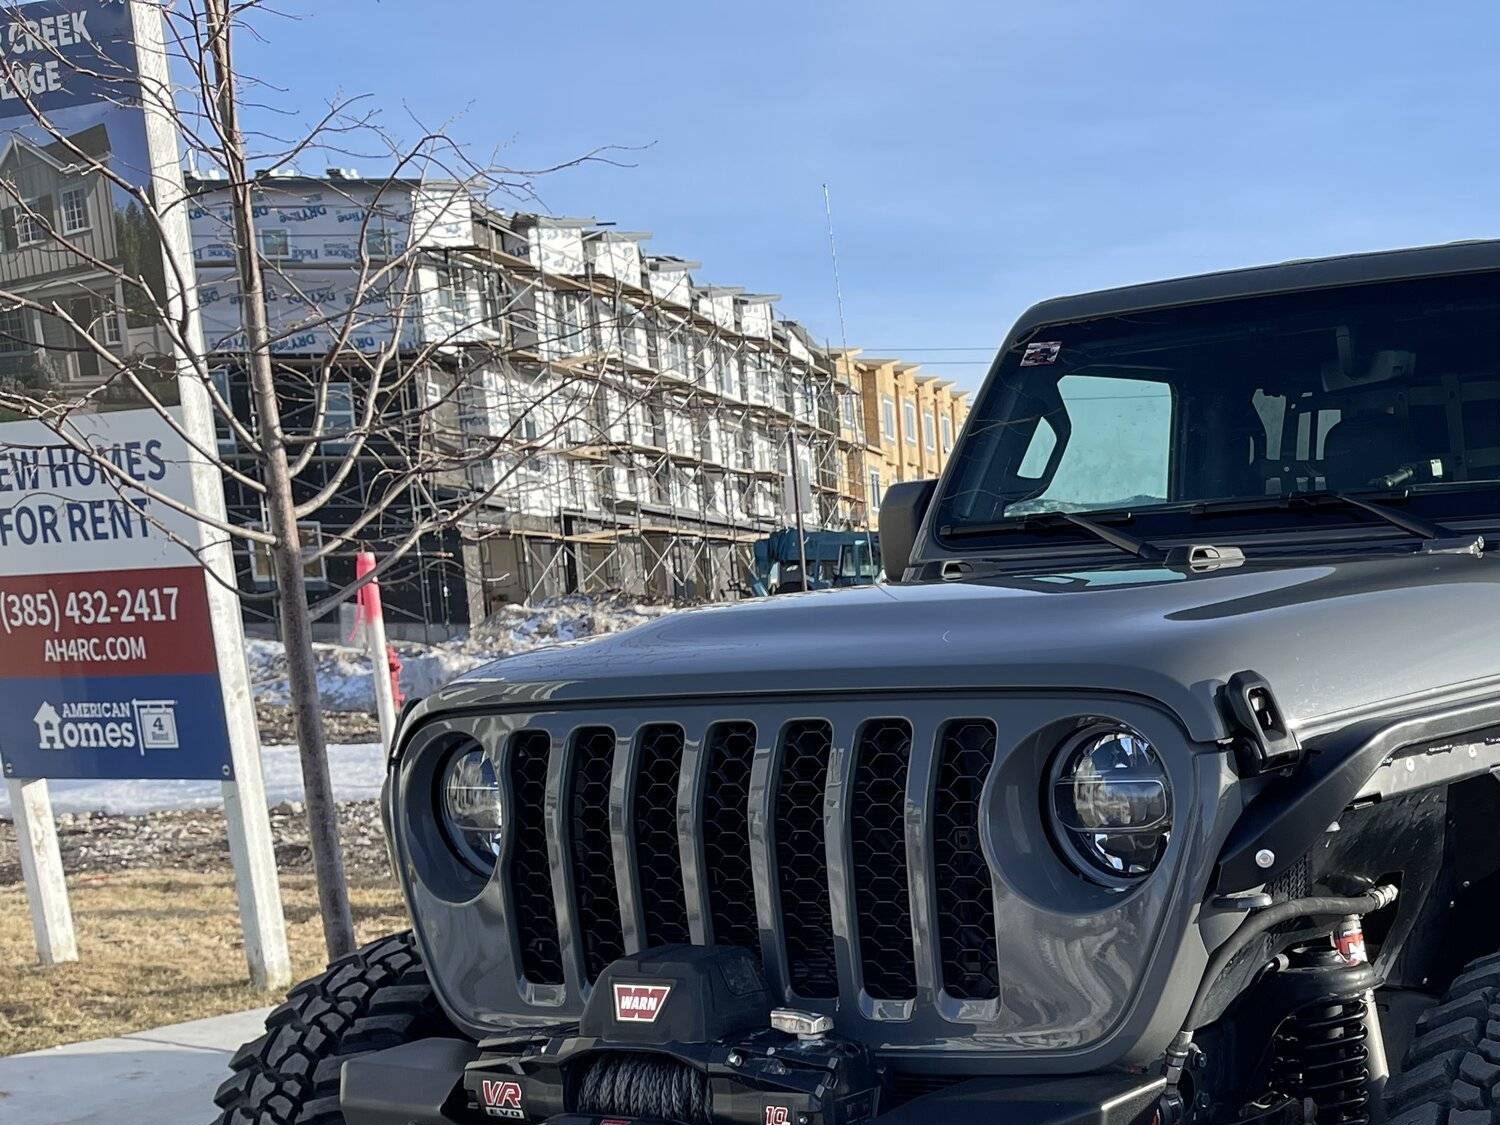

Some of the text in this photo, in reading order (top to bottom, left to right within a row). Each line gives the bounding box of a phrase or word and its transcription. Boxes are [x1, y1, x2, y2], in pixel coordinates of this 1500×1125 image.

[8, 10, 92, 54] CREEK
[0, 60, 62, 101] LAGE
[0, 439, 166, 492] EW HOMES
[0, 497, 149, 546] FOR RENT
[0, 586, 179, 634] (385) 432-2417
[45, 636, 147, 663] AH4RC.COM
[33, 701, 136, 749] Homes
[62, 702, 165, 731] AMERICAN 4
[620, 995, 658, 1011] WARN
[482, 1079, 522, 1109] VR
